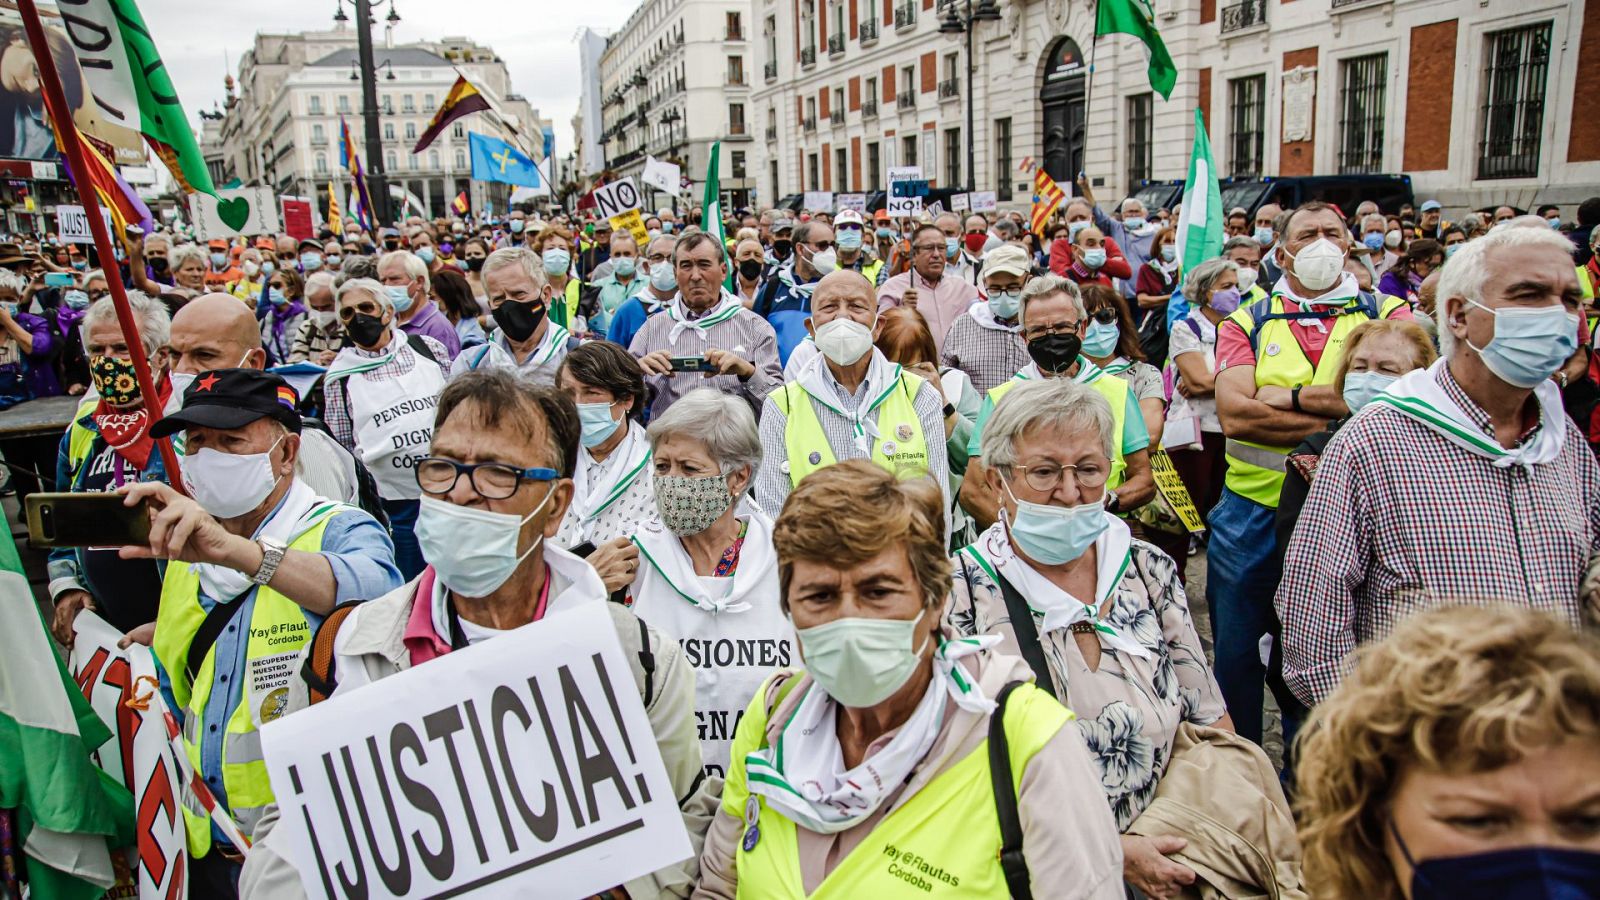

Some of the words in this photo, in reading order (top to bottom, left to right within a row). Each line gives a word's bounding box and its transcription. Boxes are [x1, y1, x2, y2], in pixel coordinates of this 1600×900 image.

[595, 181, 637, 218] NO
[890, 200, 919, 212] NO!
[250, 621, 309, 639] Yay@Flaut
[268, 634, 304, 646] Córdoba
[679, 638, 791, 668] SIONES
[253, 663, 287, 676] NUESTRO
[288, 652, 653, 900] ¡JUSTICIA!
[883, 843, 960, 887] Yay@Flautas
[888, 863, 933, 893] Córdoba
